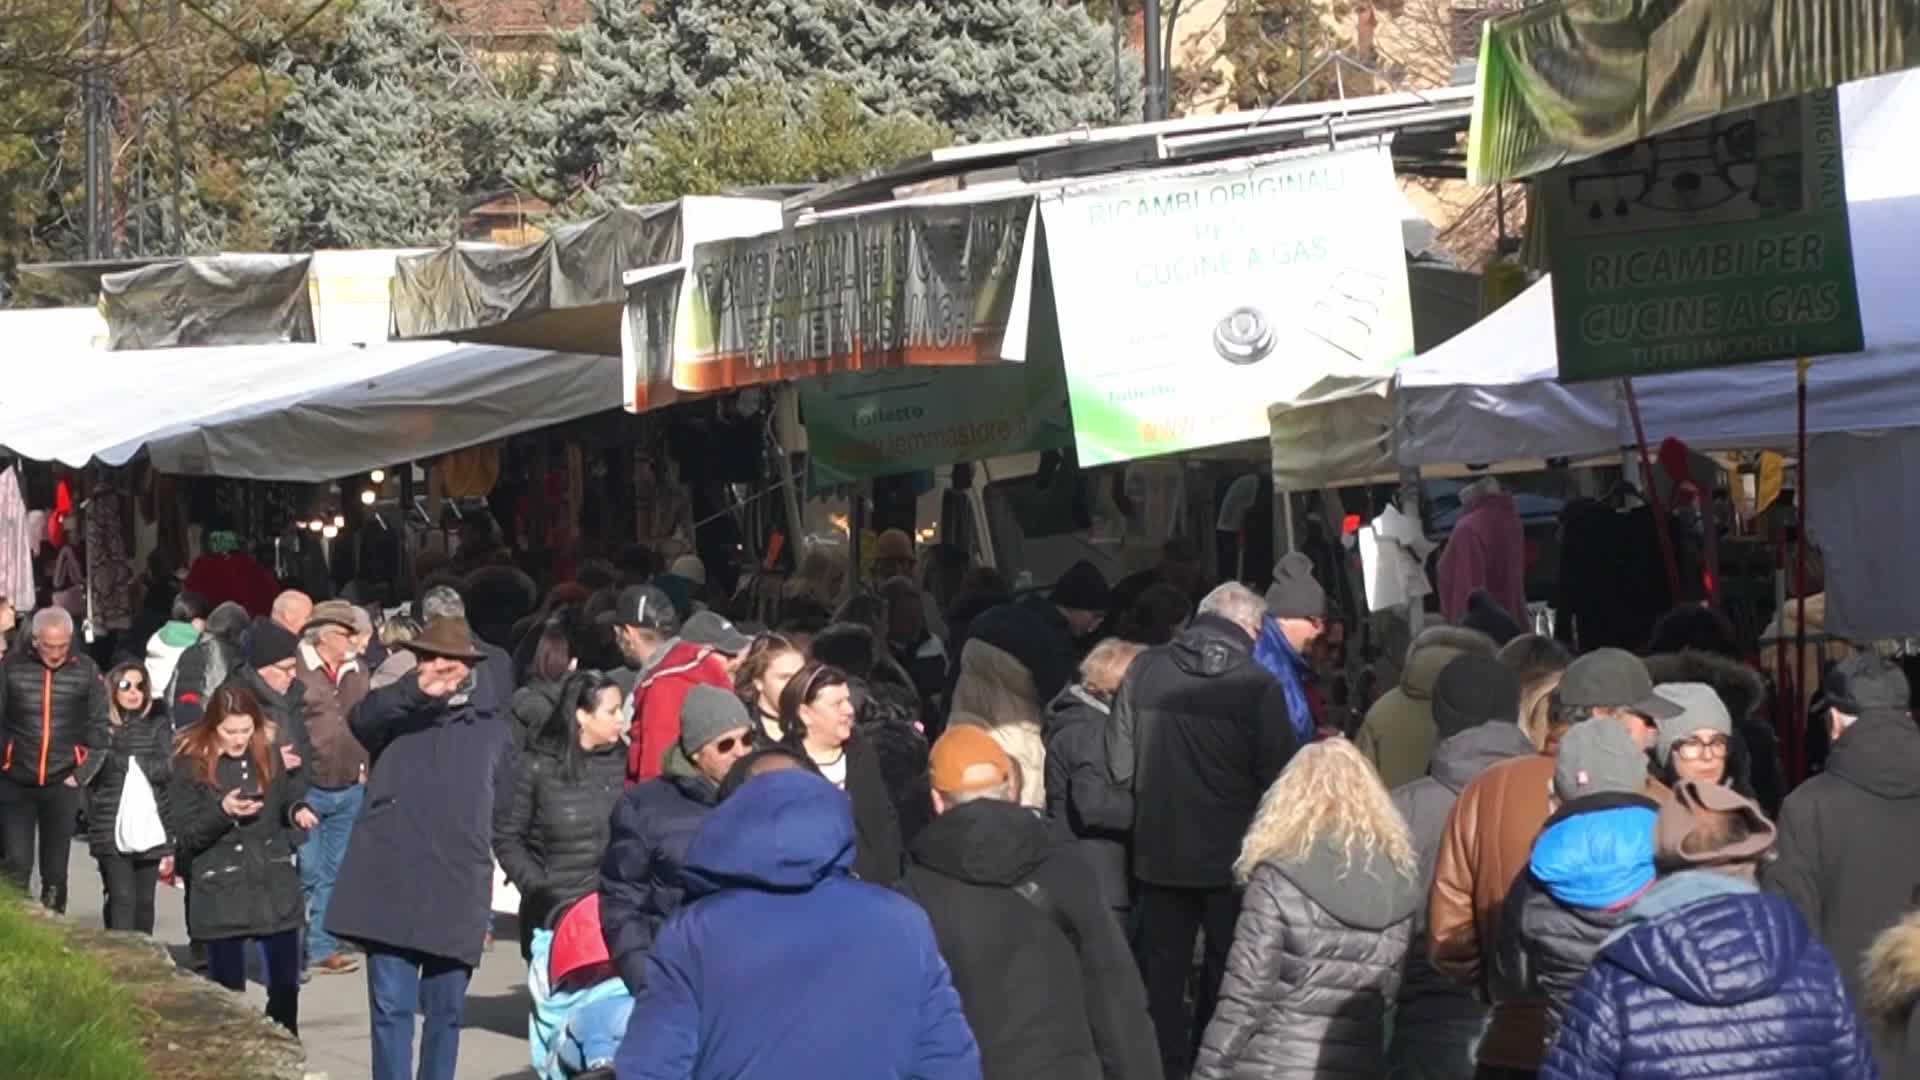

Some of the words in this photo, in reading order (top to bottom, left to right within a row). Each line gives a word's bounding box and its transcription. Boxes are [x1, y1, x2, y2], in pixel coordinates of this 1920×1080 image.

[1088, 190, 1199, 225] RICAMBI
[1210, 167, 1345, 208] ORIGINALI
[1136, 252, 1233, 289] CUCINE
[1246, 241, 1265, 272] A
[1272, 233, 1329, 266] GAS
[1587, 240, 1748, 290] RICAMBI
[1754, 231, 1825, 276] PER
[1582, 294, 1722, 345] CUCINE
[1726, 293, 1756, 330] A
[1762, 281, 1840, 327] GAS
[1630, 338, 1689, 368] TUTTI
[1703, 333, 1796, 361] MODELLI
